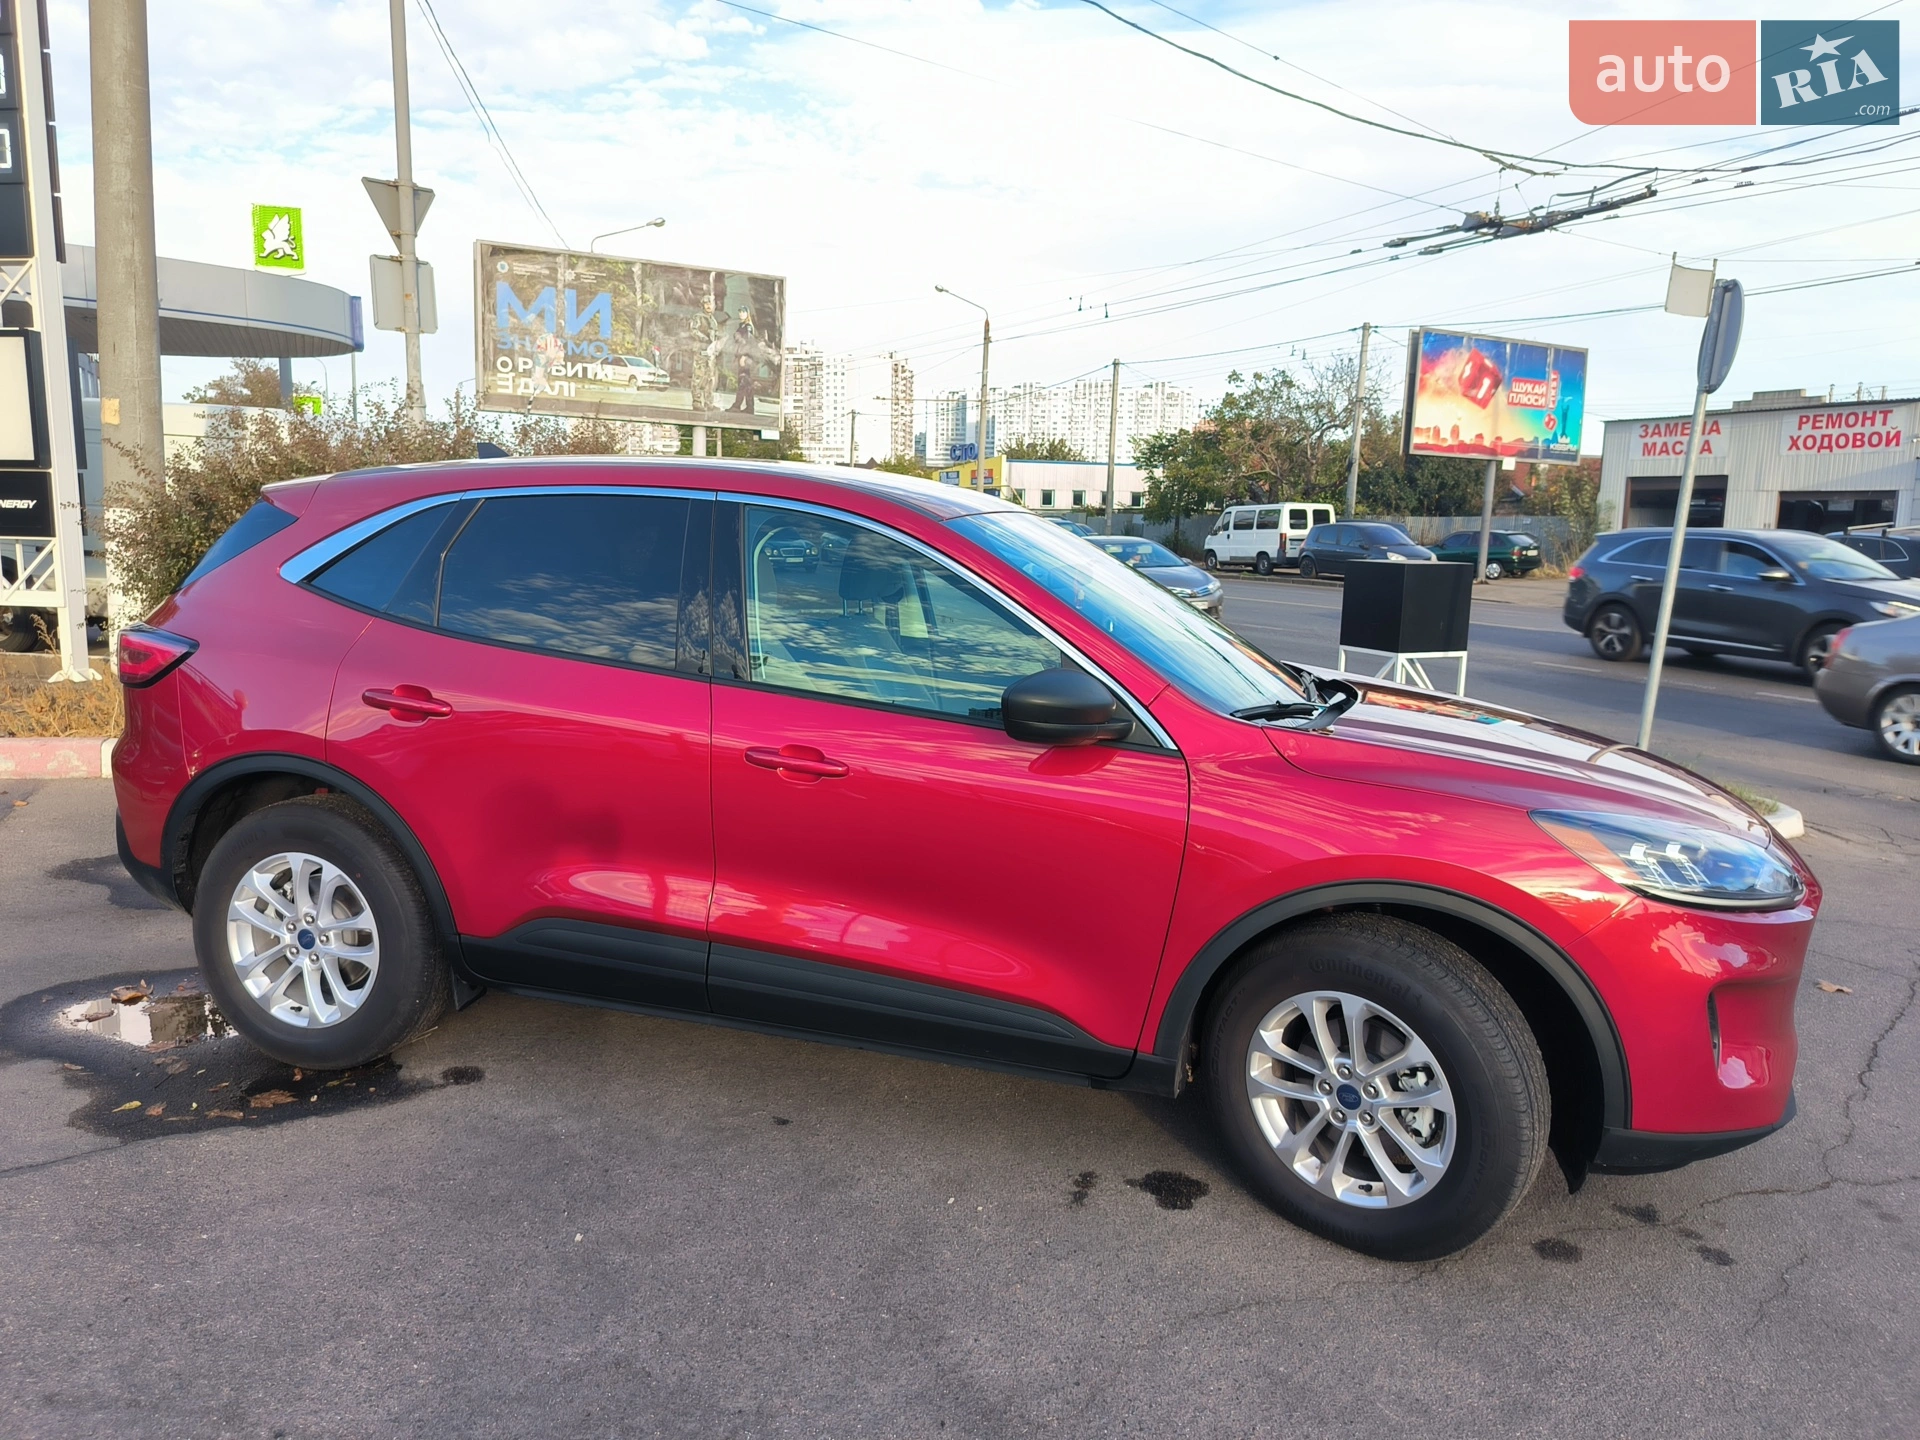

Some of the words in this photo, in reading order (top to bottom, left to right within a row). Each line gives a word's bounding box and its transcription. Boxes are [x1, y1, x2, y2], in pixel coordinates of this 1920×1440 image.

[496, 281, 613, 340] МИ
[496, 331, 613, 362] ЗНМО,
[518, 357, 613, 380] РБИТИ
[1512, 381, 1547, 394] ШУКАЙ
[1509, 392, 1546, 407] ПЛЮСИ
[1797, 409, 1894, 431] РЕМОНТ
[1642, 440, 1712, 457] МАСА
[1787, 426, 1902, 453] ХОДОВОЙ
[950, 442, 979, 462] СТО
